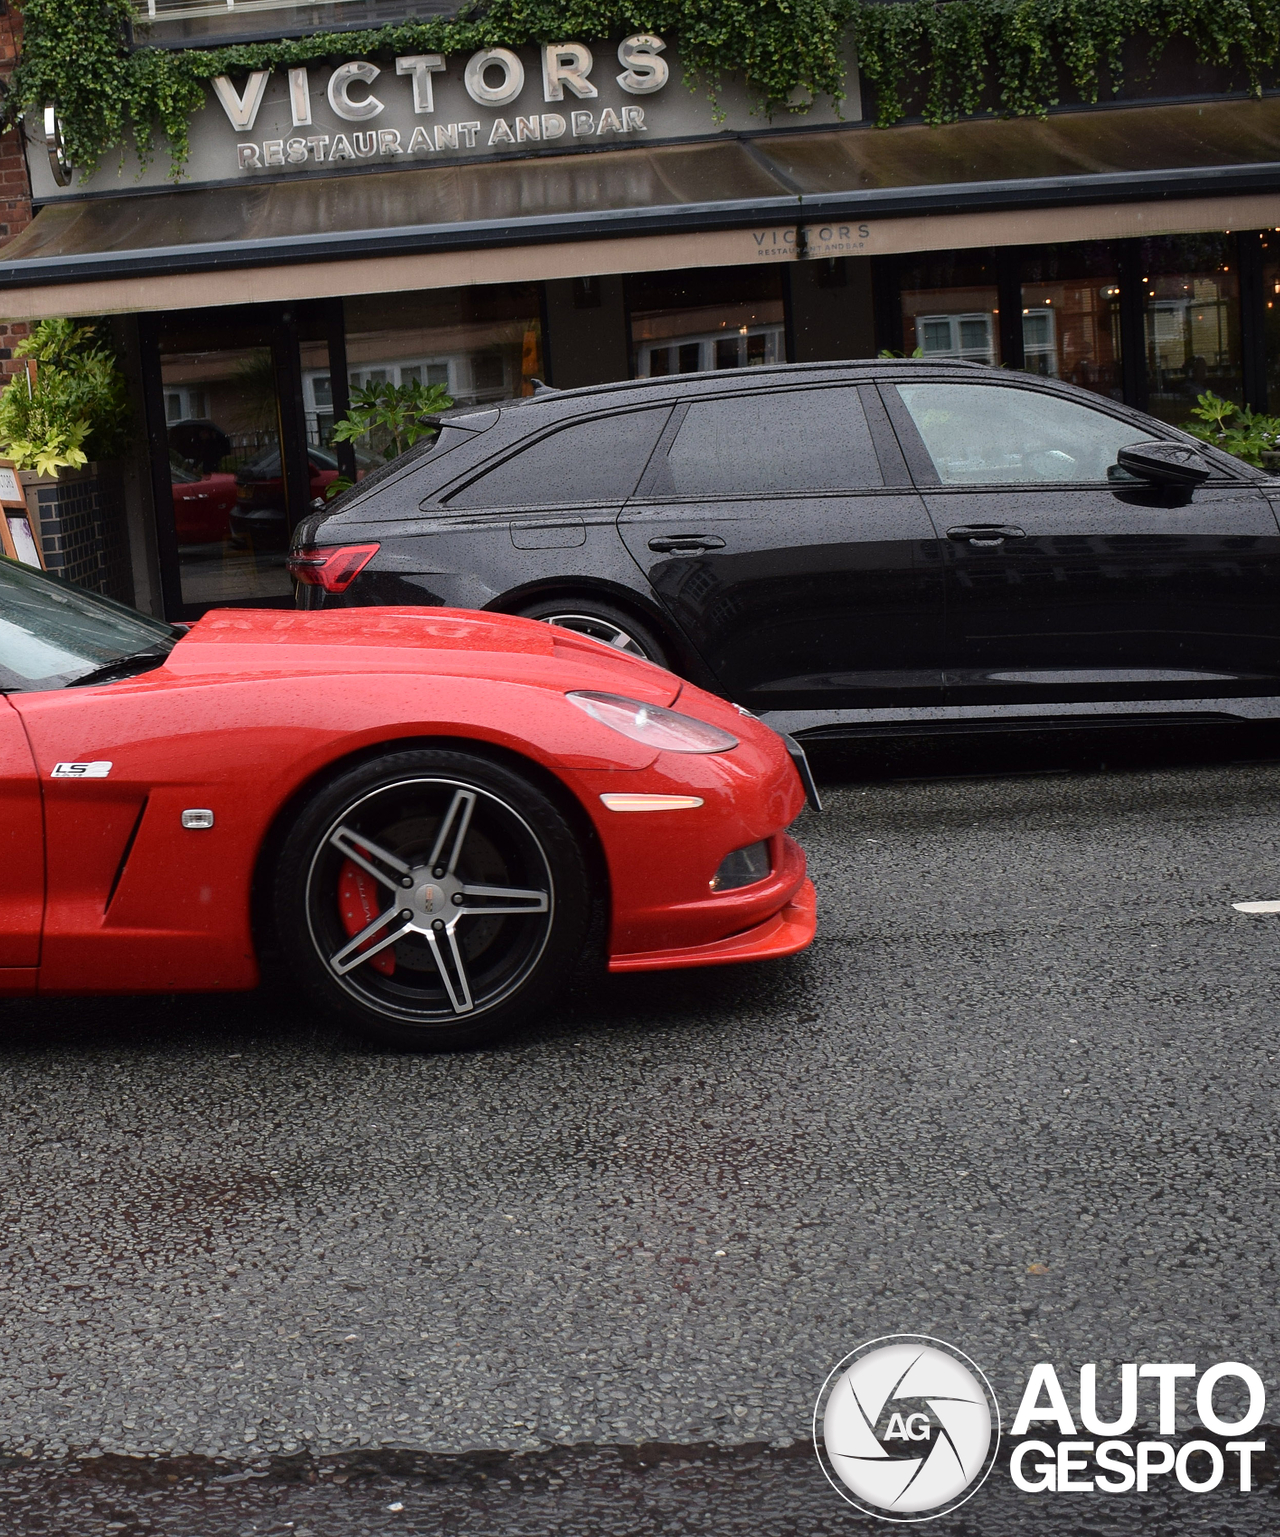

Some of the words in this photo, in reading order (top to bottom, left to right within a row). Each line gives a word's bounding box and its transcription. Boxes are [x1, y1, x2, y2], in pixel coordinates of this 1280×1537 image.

[210, 32, 669, 132] VICTORS
[237, 121, 481, 170] RESTAURANT
[488, 113, 567, 146] AND
[571, 105, 648, 138] BAR
[753, 224, 870, 245] VICTORS
